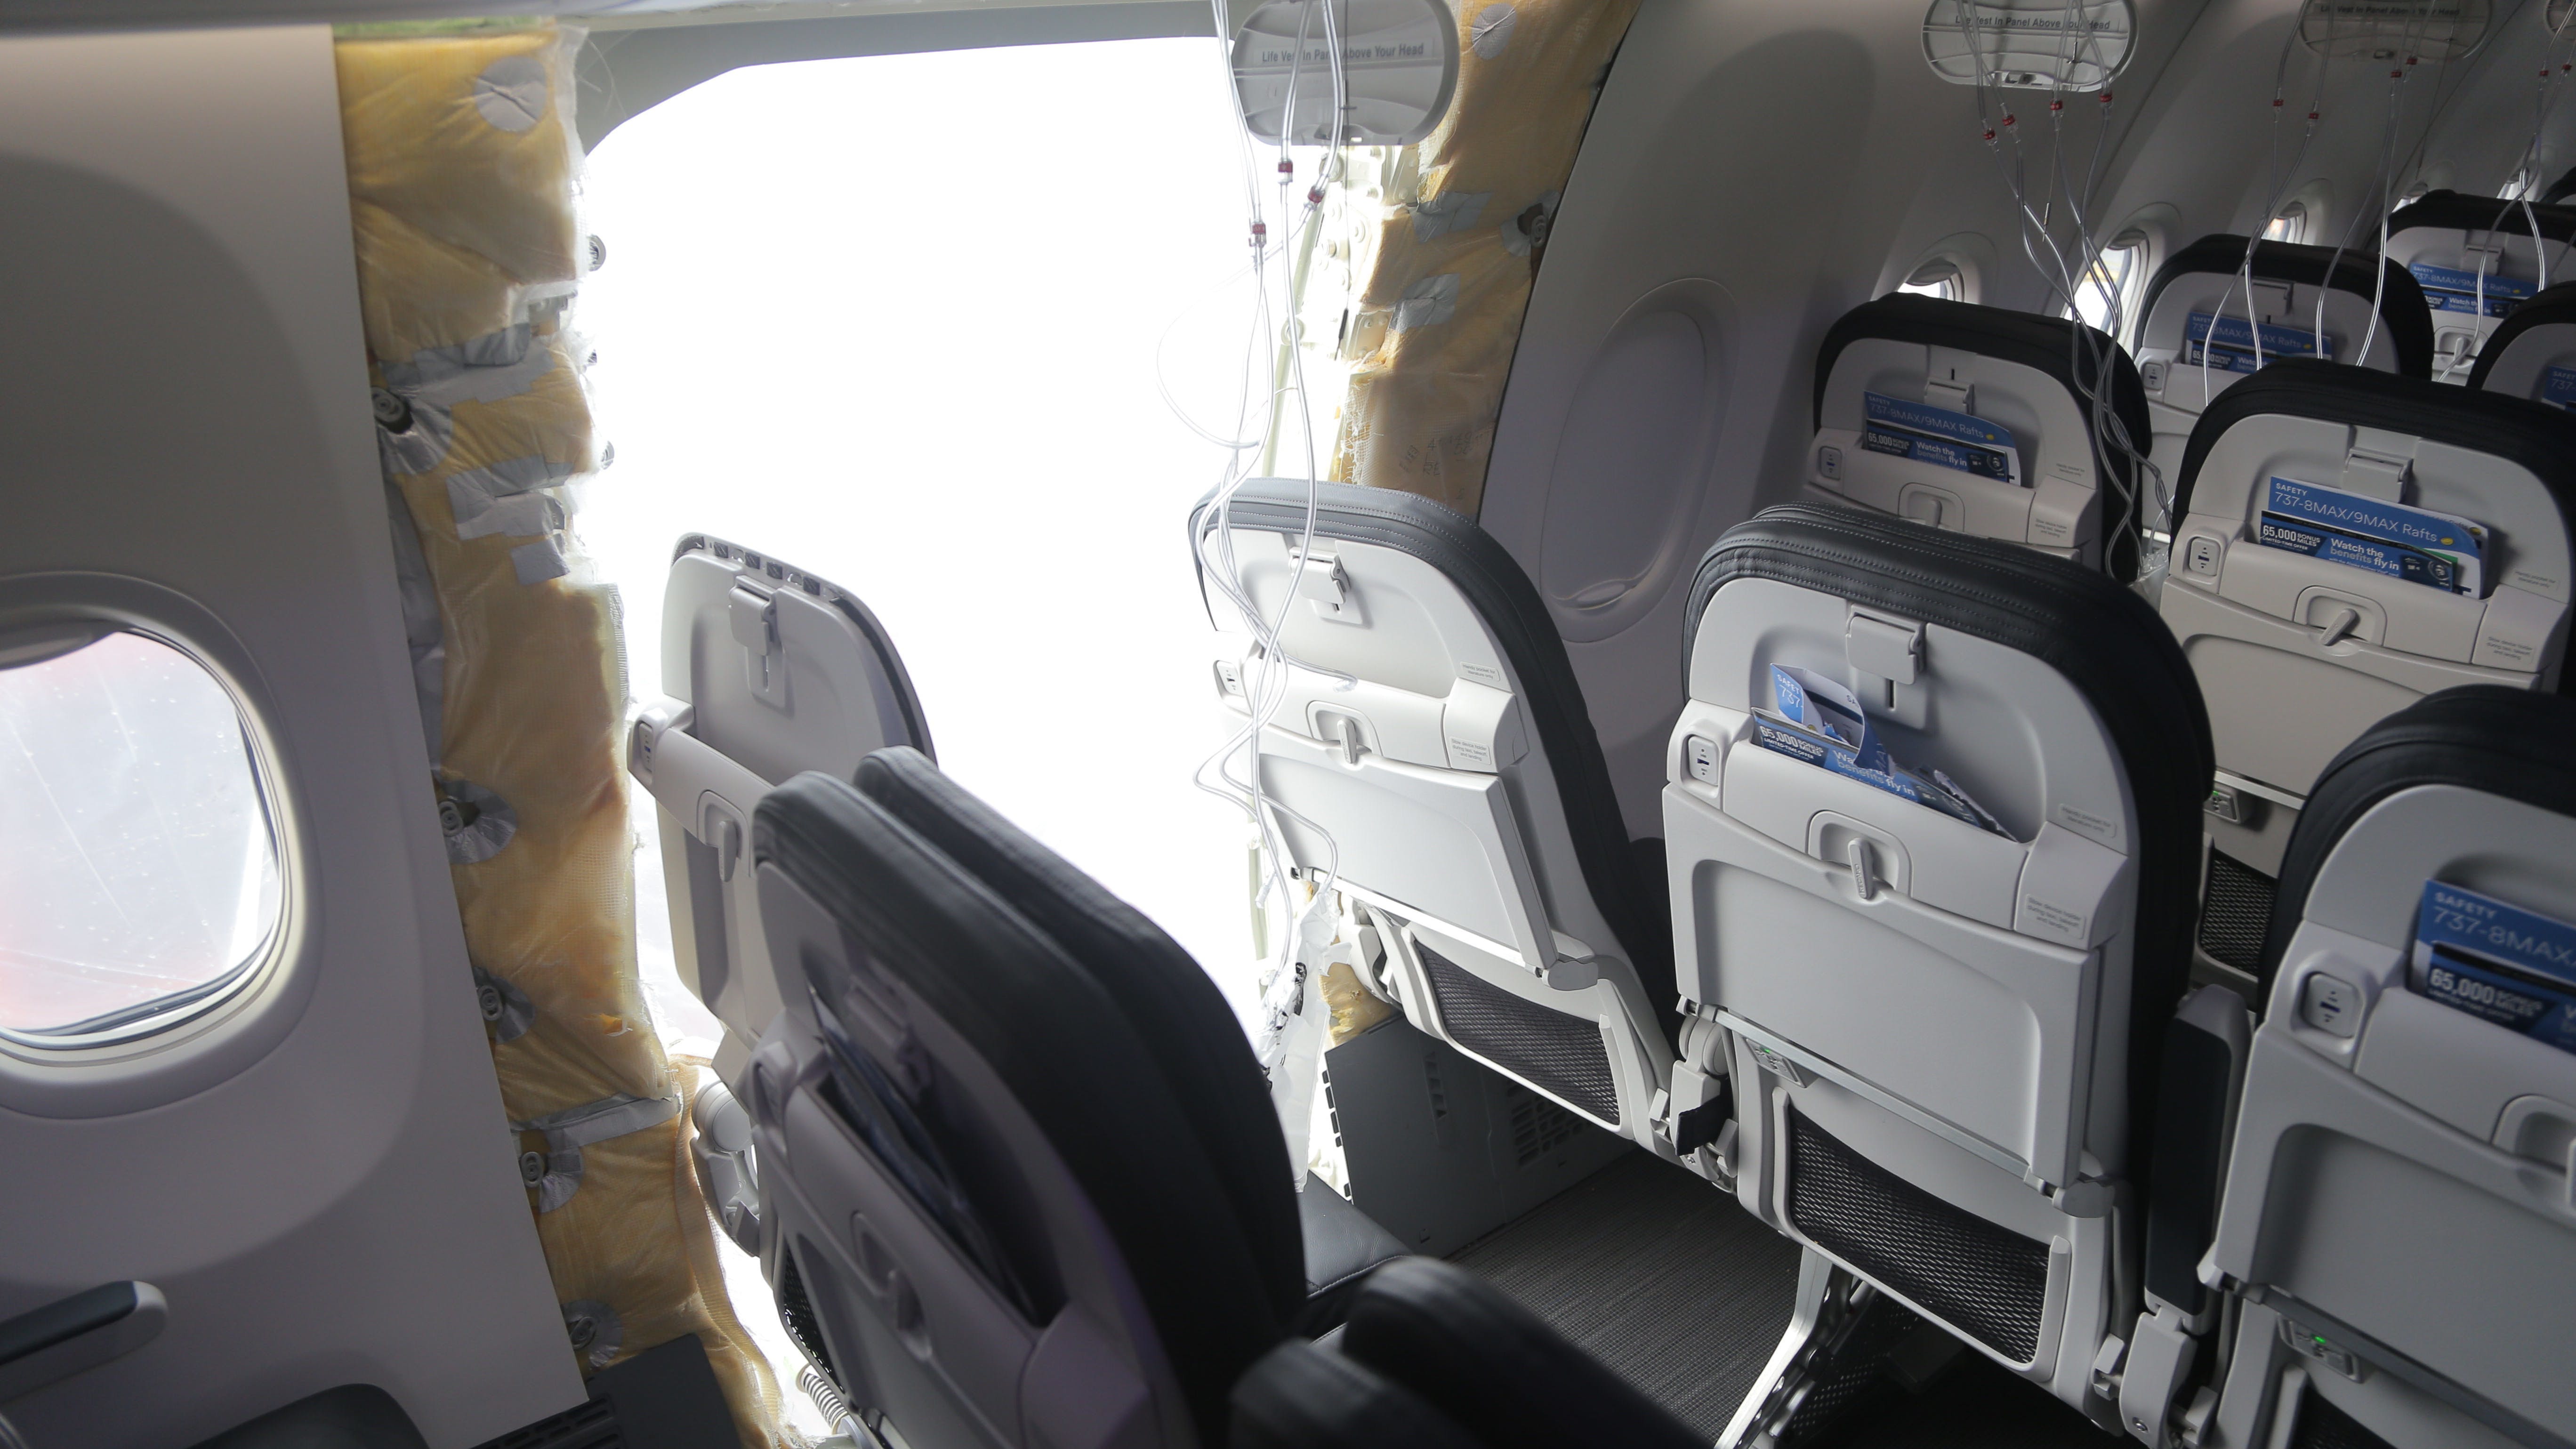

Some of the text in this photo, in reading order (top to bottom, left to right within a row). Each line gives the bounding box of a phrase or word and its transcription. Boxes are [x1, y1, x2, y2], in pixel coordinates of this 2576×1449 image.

[2006, 17, 2030, 26] Panel
[2032, 18, 2061, 27] Above
[1263, 51, 1279, 62] Life
[1281, 50, 1297, 62] Ves
[1303, 49, 1312, 60] In
[1342, 48, 1372, 58] Above
[1375, 45, 1396, 57] Your
[1399, 42, 1425, 56] Head
[1868, 432, 1892, 446] 65,000
[1959, 424, 1984, 438] Rafts
[1916, 441, 1955, 456] Watch the
[1948, 455, 1959, 466] fly
[1959, 458, 1967, 467] in
[2276, 483, 2308, 496] SAFETY
[2274, 491, 2399, 532] 737-8MAX/9MAX
[2402, 523, 2438, 542] Rafts
[2263, 525, 2296, 542] 65,000
[2297, 533, 2321, 543] BONUS
[2297, 538, 2317, 547] MILES
[2330, 538, 2384, 558] Watch the
[2330, 546, 2399, 571] benefits fly in
[1777, 674, 1801, 694] SAFET
[1759, 725, 1799, 748] 65,000
[1885, 778, 1901, 792] fly
[1903, 784, 1916, 797] in
[2434, 892, 2497, 918] SAFETY
[2429, 968, 2495, 1005] 65,000
